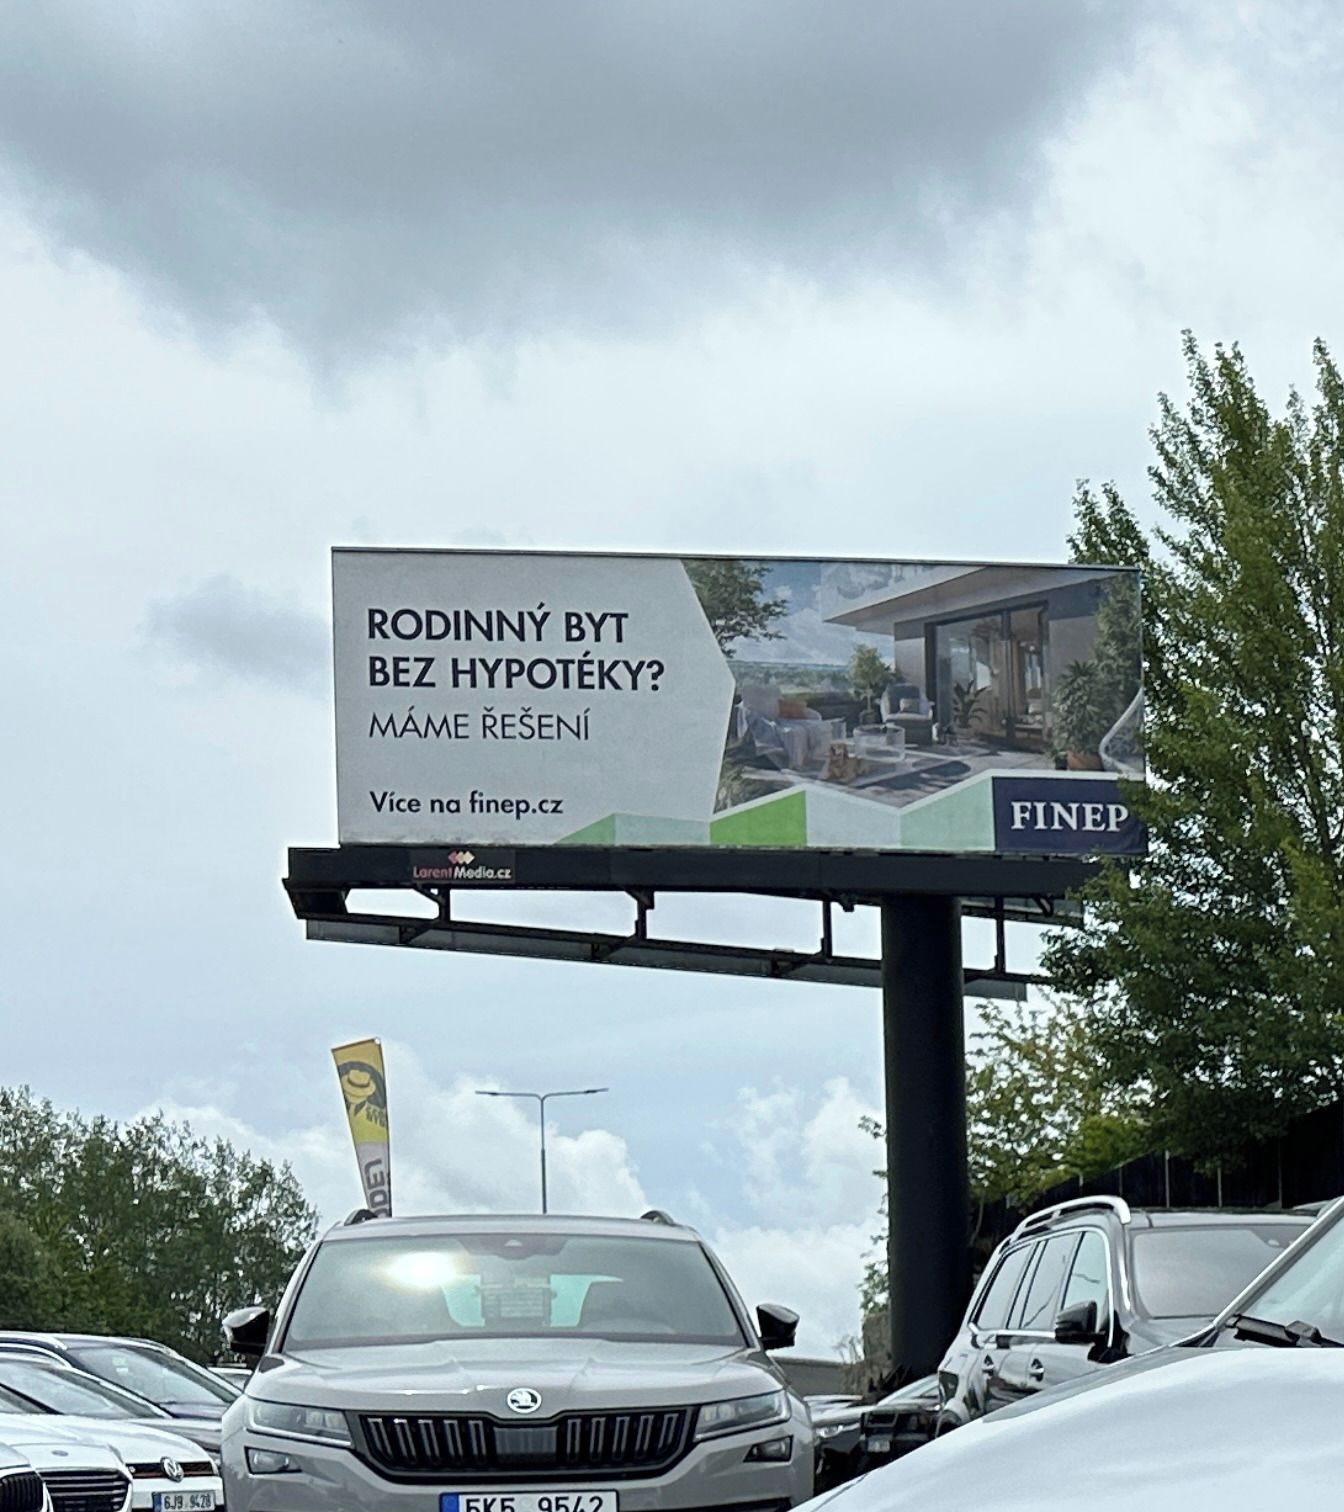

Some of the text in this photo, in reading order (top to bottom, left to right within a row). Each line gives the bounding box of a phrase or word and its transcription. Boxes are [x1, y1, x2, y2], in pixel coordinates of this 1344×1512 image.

[367, 602, 628, 642] RODINNÝ BYT
[369, 651, 664, 691] BEZ HYPOTÉKY?
[369, 705, 590, 740] MÁME ŘEŠENÍ
[369, 790, 564, 820] Více na finep.cz
[1011, 801, 1128, 832] FINEP
